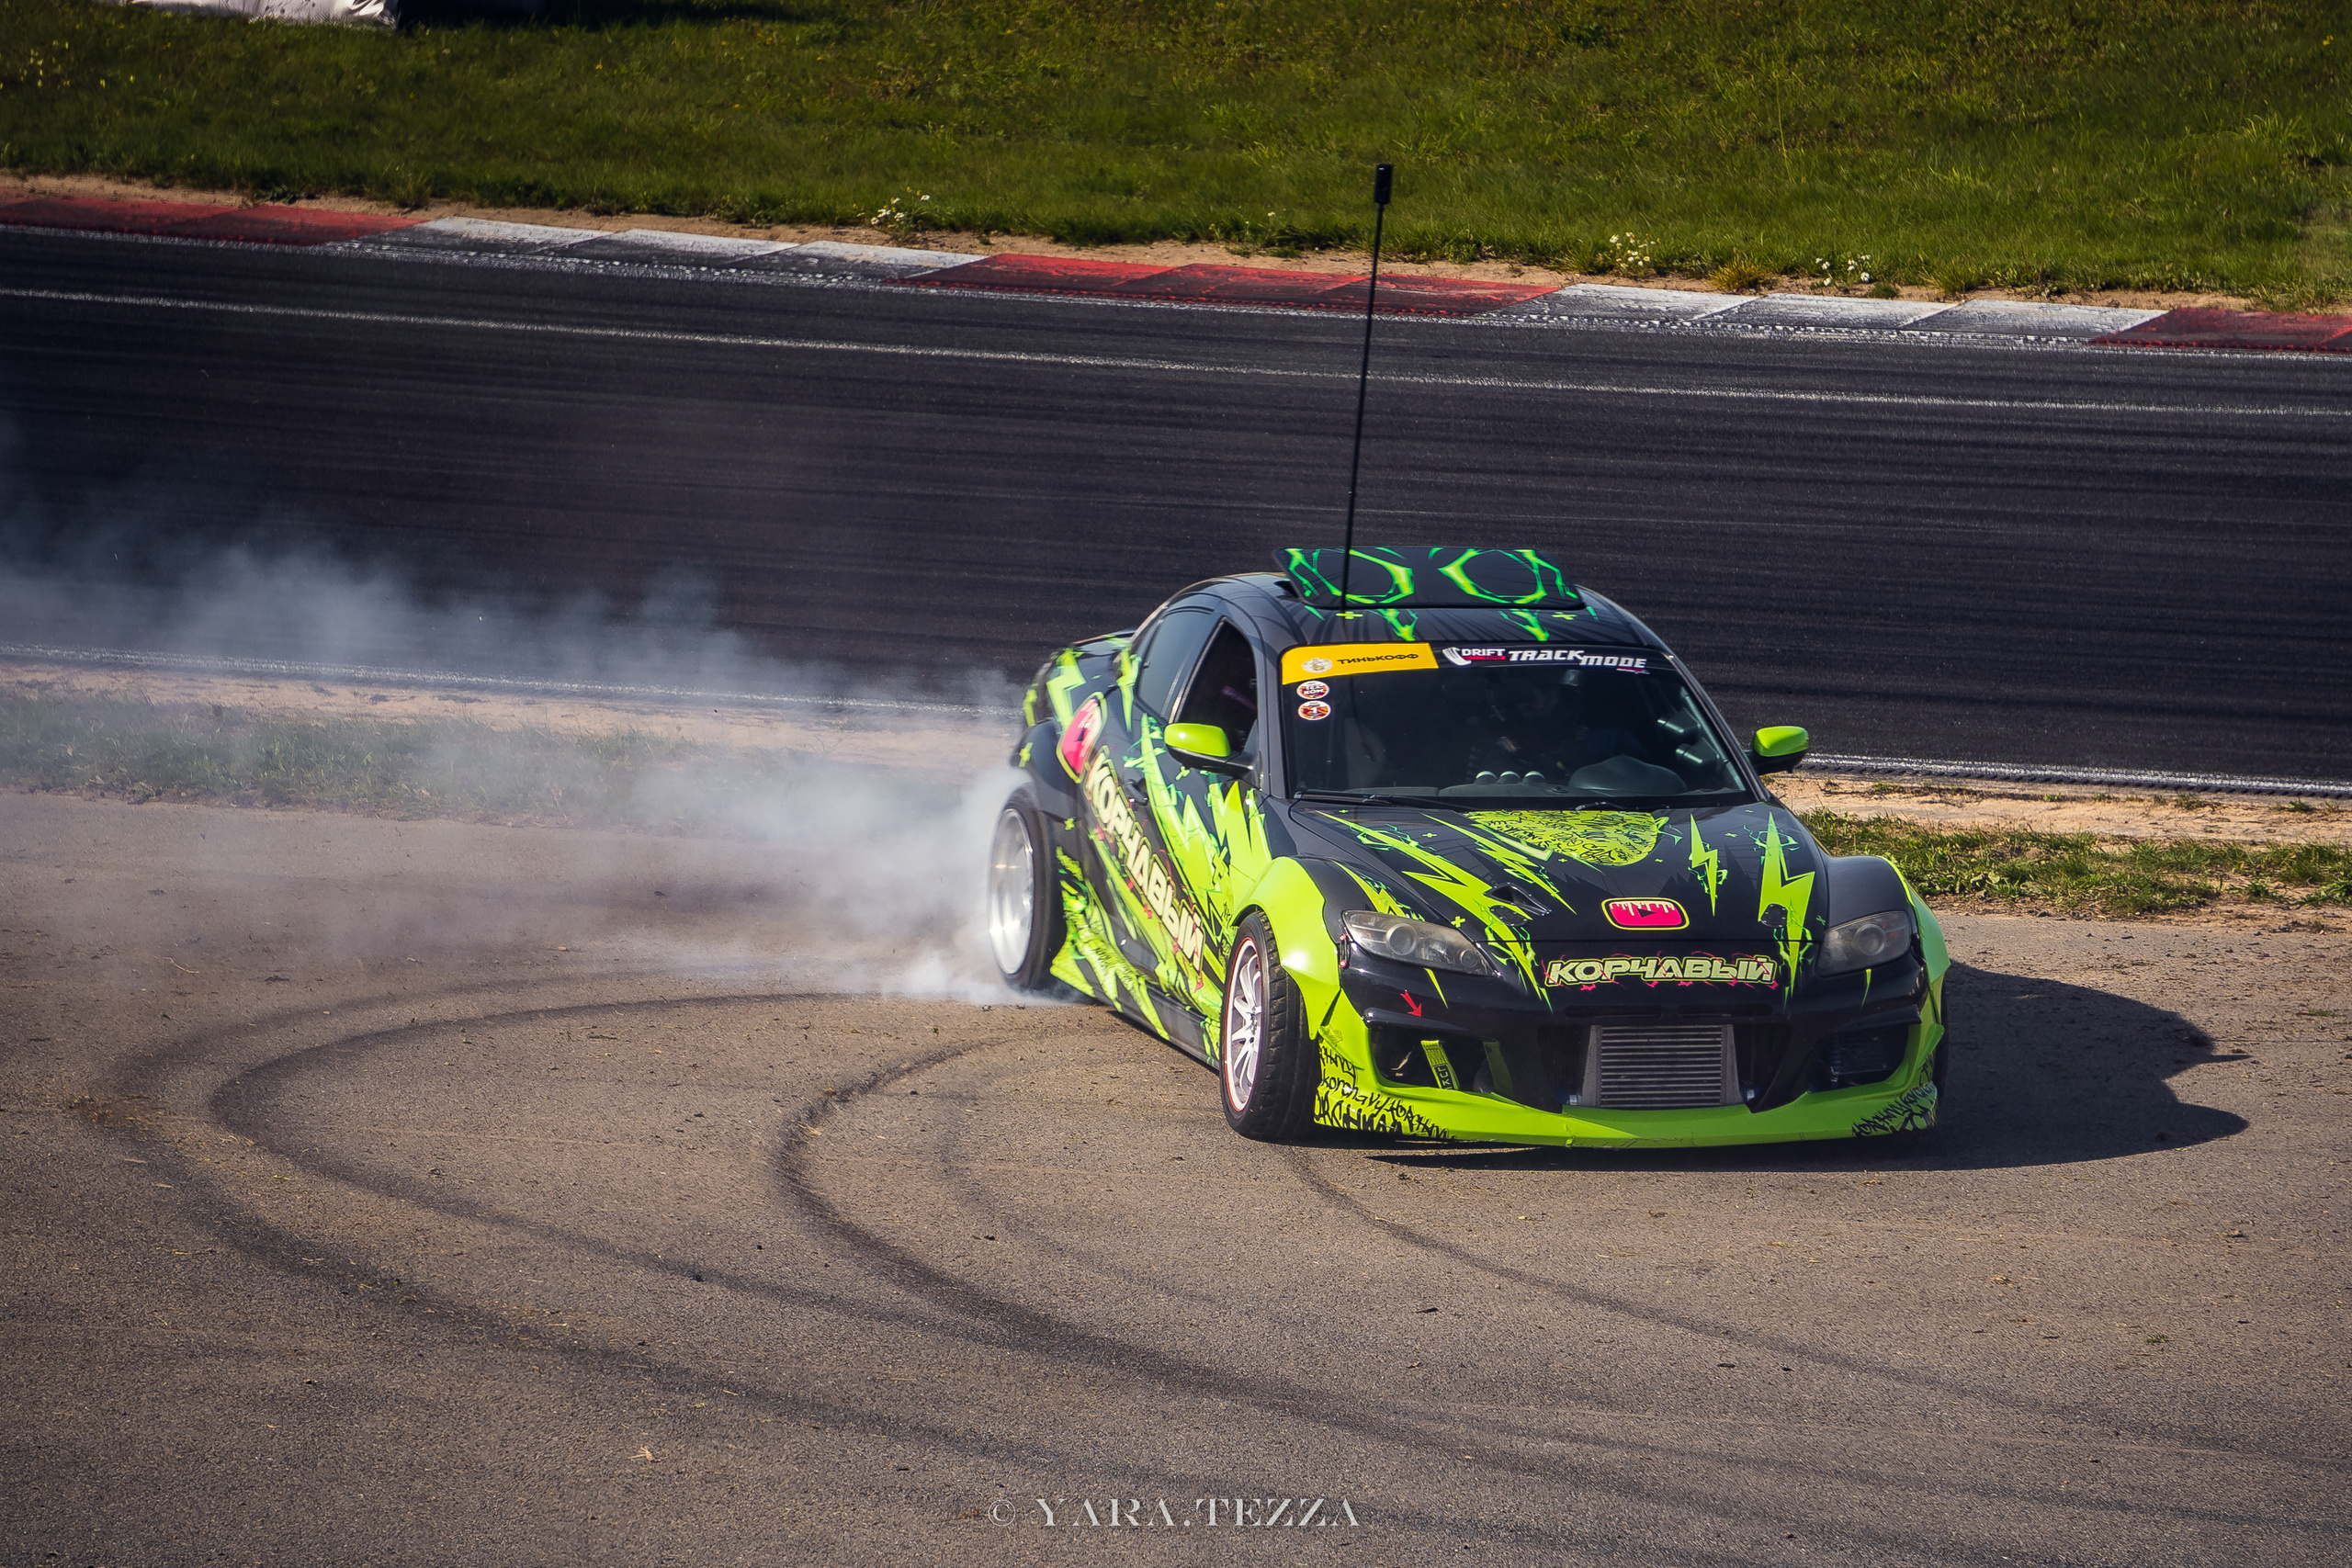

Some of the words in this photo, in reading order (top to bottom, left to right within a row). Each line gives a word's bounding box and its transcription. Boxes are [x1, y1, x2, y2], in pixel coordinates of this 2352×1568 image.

[1337, 653, 1419, 665] ТИНЬКОФФ
[1086, 746, 1205, 972] КОРЧАВЫЙ
[1545, 955, 1776, 986] КОРЧАВЫЙ
